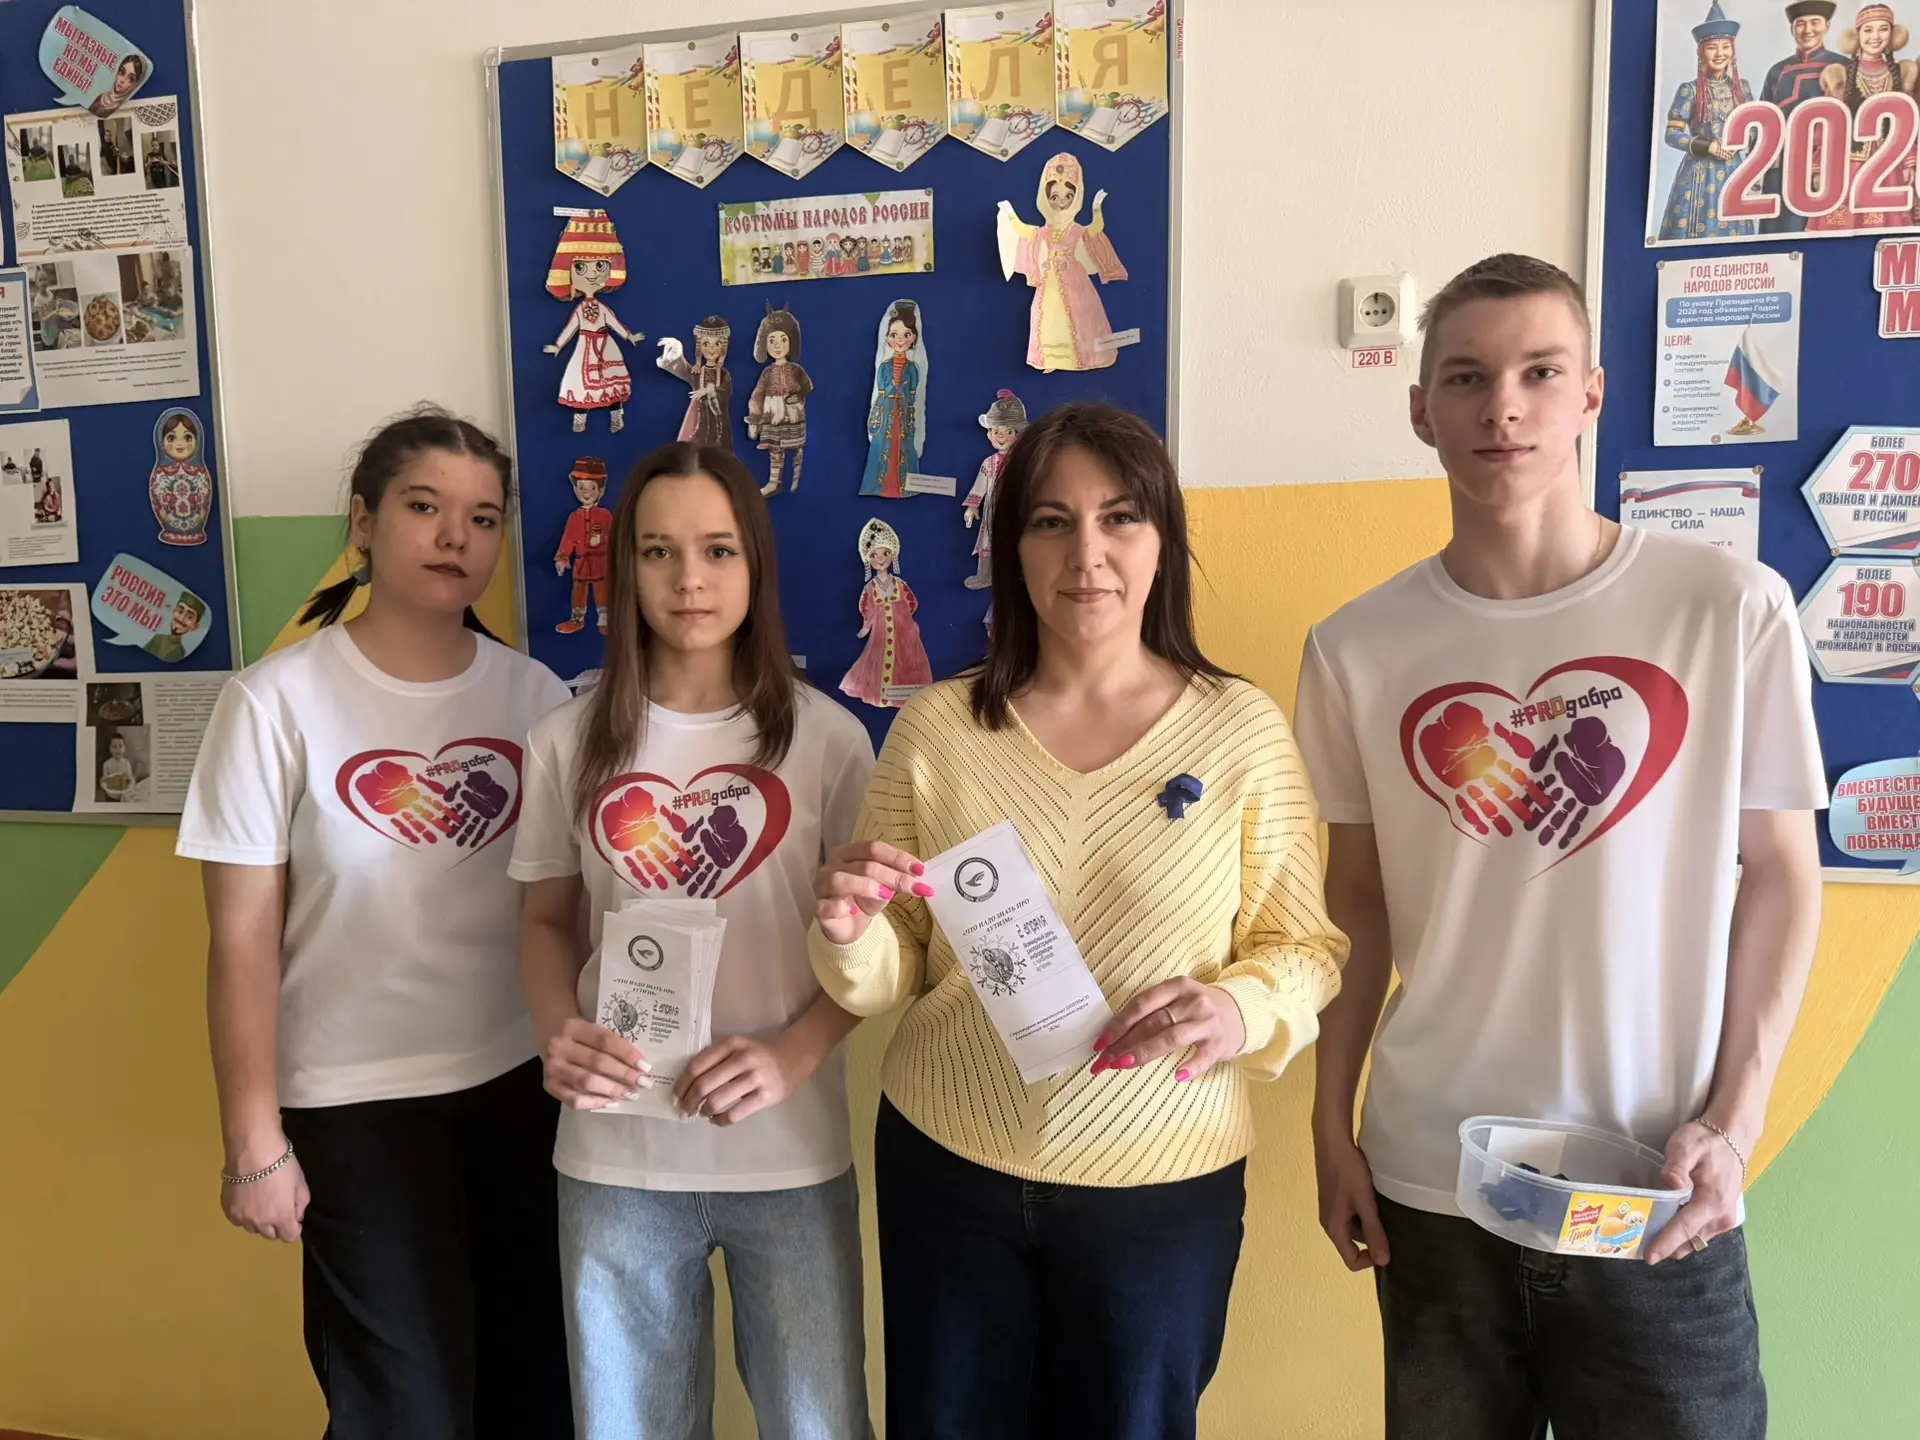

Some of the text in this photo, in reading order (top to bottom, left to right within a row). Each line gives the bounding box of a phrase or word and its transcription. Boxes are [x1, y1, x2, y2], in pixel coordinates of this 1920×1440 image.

[54, 17, 79, 42] МЫ
[63, 43, 98, 77] НО МЫ
[53, 58, 92, 93] ЕДИНЫ!
[1718, 92, 1920, 221] 202
[724, 201, 929, 233] КОСТЮМЫ НАРОДОВ РОССИИ
[1691, 262, 1768, 278] ГОД ЕДИНСТВА
[1879, 243, 1920, 286] М
[1684, 277, 1775, 293] НАРОДОВ РОССИИ
[1664, 335, 1692, 348] ЦЕЛИ:
[1359, 351, 1392, 366] 220 В
[1871, 436, 1904, 448] БОЛЕЕ
[1848, 451, 1920, 492] 270
[1819, 492, 1864, 505] ЯЗЫКОВ
[1870, 494, 1877, 505] И
[1631, 508, 1692, 520] ЕДИНСТВО
[1710, 507, 1745, 517] НАША
[1853, 510, 1906, 522] В РОССИИ
[1671, 520, 1704, 530] СИЛА
[1857, 568, 1890, 580] БОЛЕЕ
[111, 564, 167, 609] РОССИЯ
[1838, 582, 1905, 618] 190
[101, 585, 163, 632] ЭТО МЫ!
[1828, 619, 1914, 631] НАЦИОНАЛЬНОСТЕЙ
[1834, 630, 1908, 641] И НАРОДНОСТЕЙ
[1816, 640, 1872, 651] ПРОЖИВАЮТ
[1876, 642, 1882, 651] В
[1837, 778, 1890, 797] ВМЕСТЕ
[1867, 814, 1920, 831] ВМЕСТ
